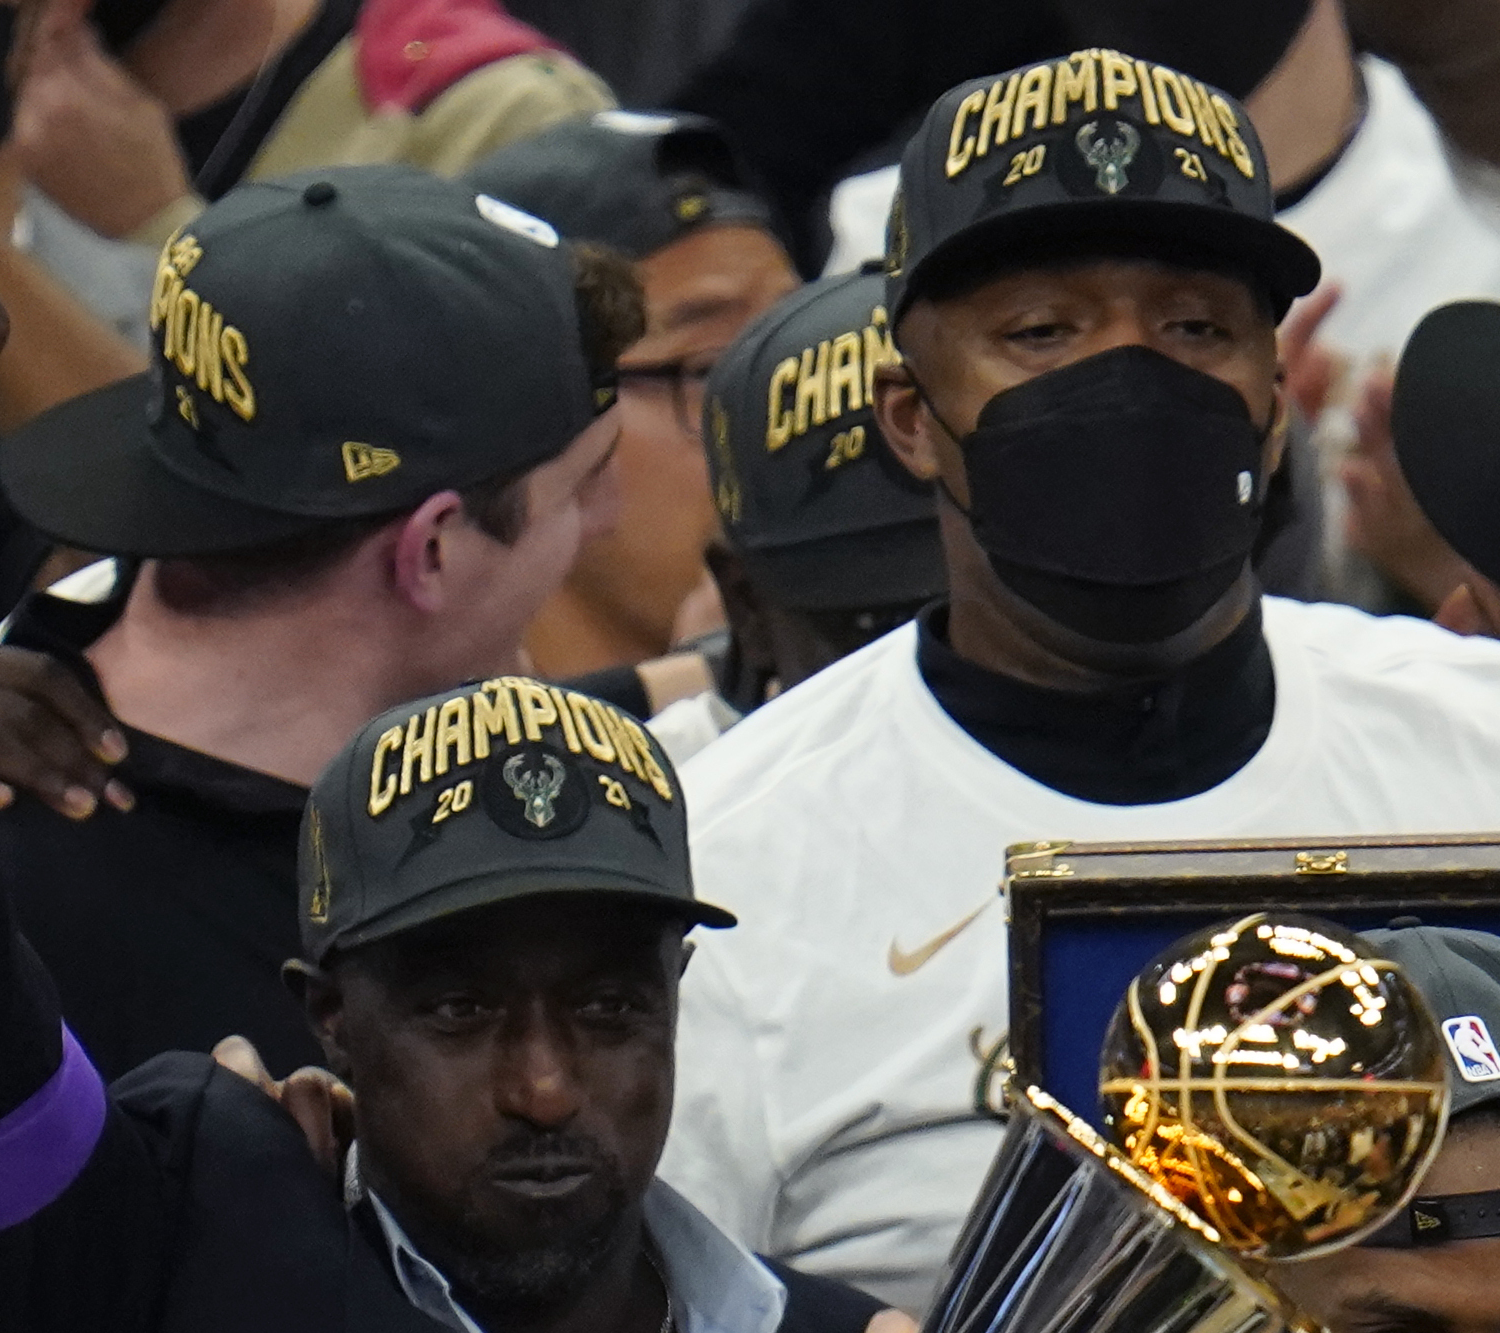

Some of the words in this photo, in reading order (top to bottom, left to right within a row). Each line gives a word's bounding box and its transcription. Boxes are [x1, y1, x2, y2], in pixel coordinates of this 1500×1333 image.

[946, 48, 1254, 179] CHAMPIONS
[1003, 144, 1046, 186] 20
[1174, 147, 1207, 182] 21
[825, 425, 866, 470] 20
[368, 683, 672, 816] CHAMPIONS
[432, 780, 474, 824] 20
